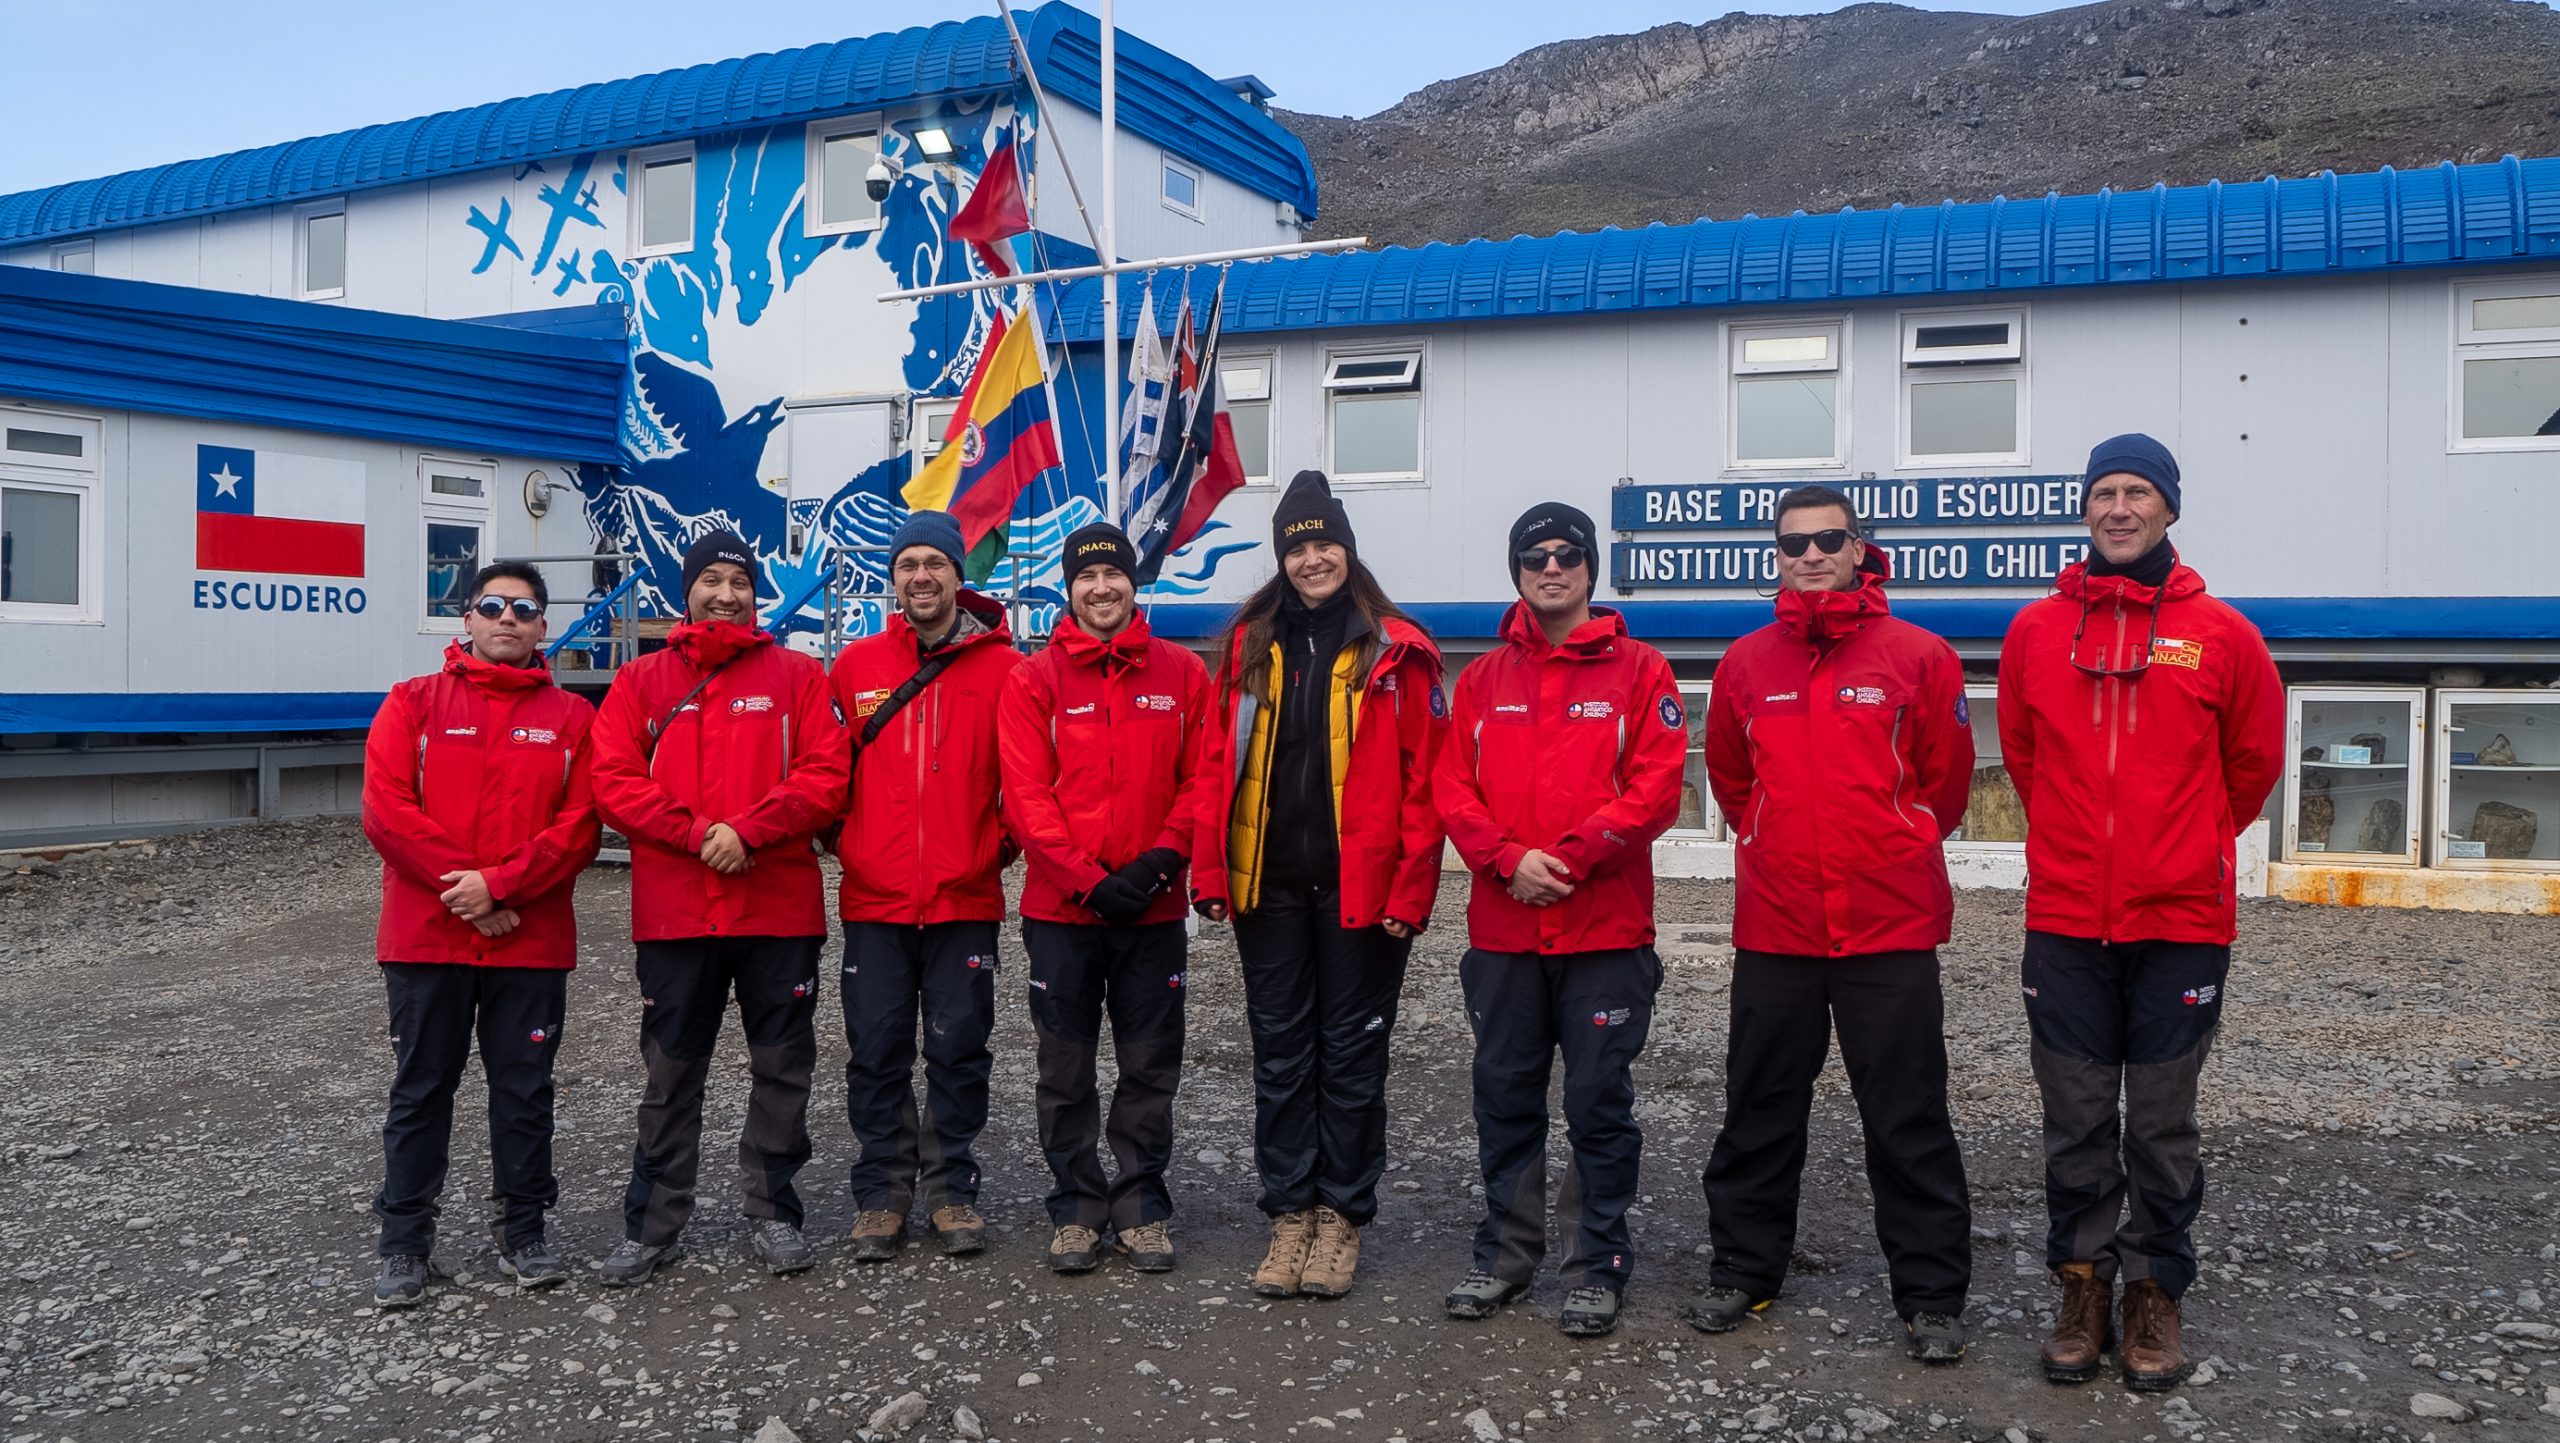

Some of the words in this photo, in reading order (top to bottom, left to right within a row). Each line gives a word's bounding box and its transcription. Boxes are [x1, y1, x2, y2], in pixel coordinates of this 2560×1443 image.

[1646, 489, 1722, 523] BASE
[1739, 488, 1792, 521] PR
[1283, 519, 1324, 537] INACH
[1078, 541, 1117, 556] INACH
[1630, 547, 1780, 581] INSTITUTO
[193, 580, 367, 614] ESCUDERO
[2155, 652, 2196, 666] INACH
